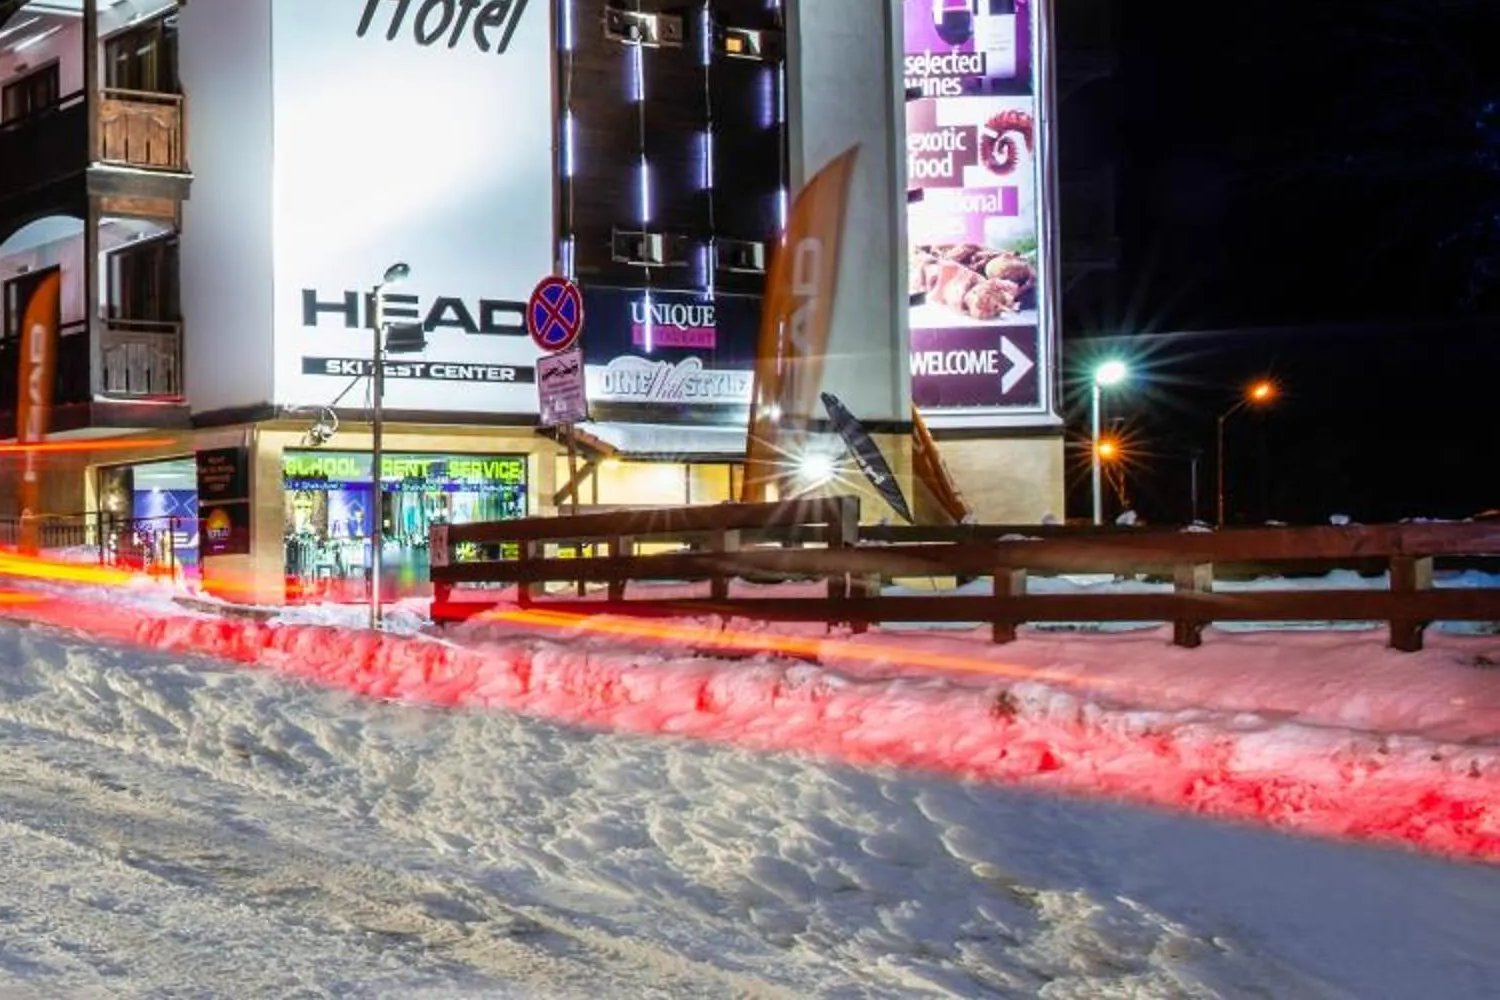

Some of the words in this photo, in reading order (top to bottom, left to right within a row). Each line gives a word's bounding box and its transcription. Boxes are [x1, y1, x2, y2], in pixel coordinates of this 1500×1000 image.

[904, 49, 982, 77] selected
[907, 126, 967, 151] exotic
[908, 152, 953, 179] food
[302, 289, 529, 336] HEAD
[631, 302, 716, 331] UNIQUE
[326, 359, 363, 375] SKI
[430, 364, 516, 381] CENTER
[910, 349, 999, 376] WELCOME
[285, 457, 361, 477] SCHOOL
[381, 459, 431, 477] RENT
[448, 459, 524, 479] SERVICE
